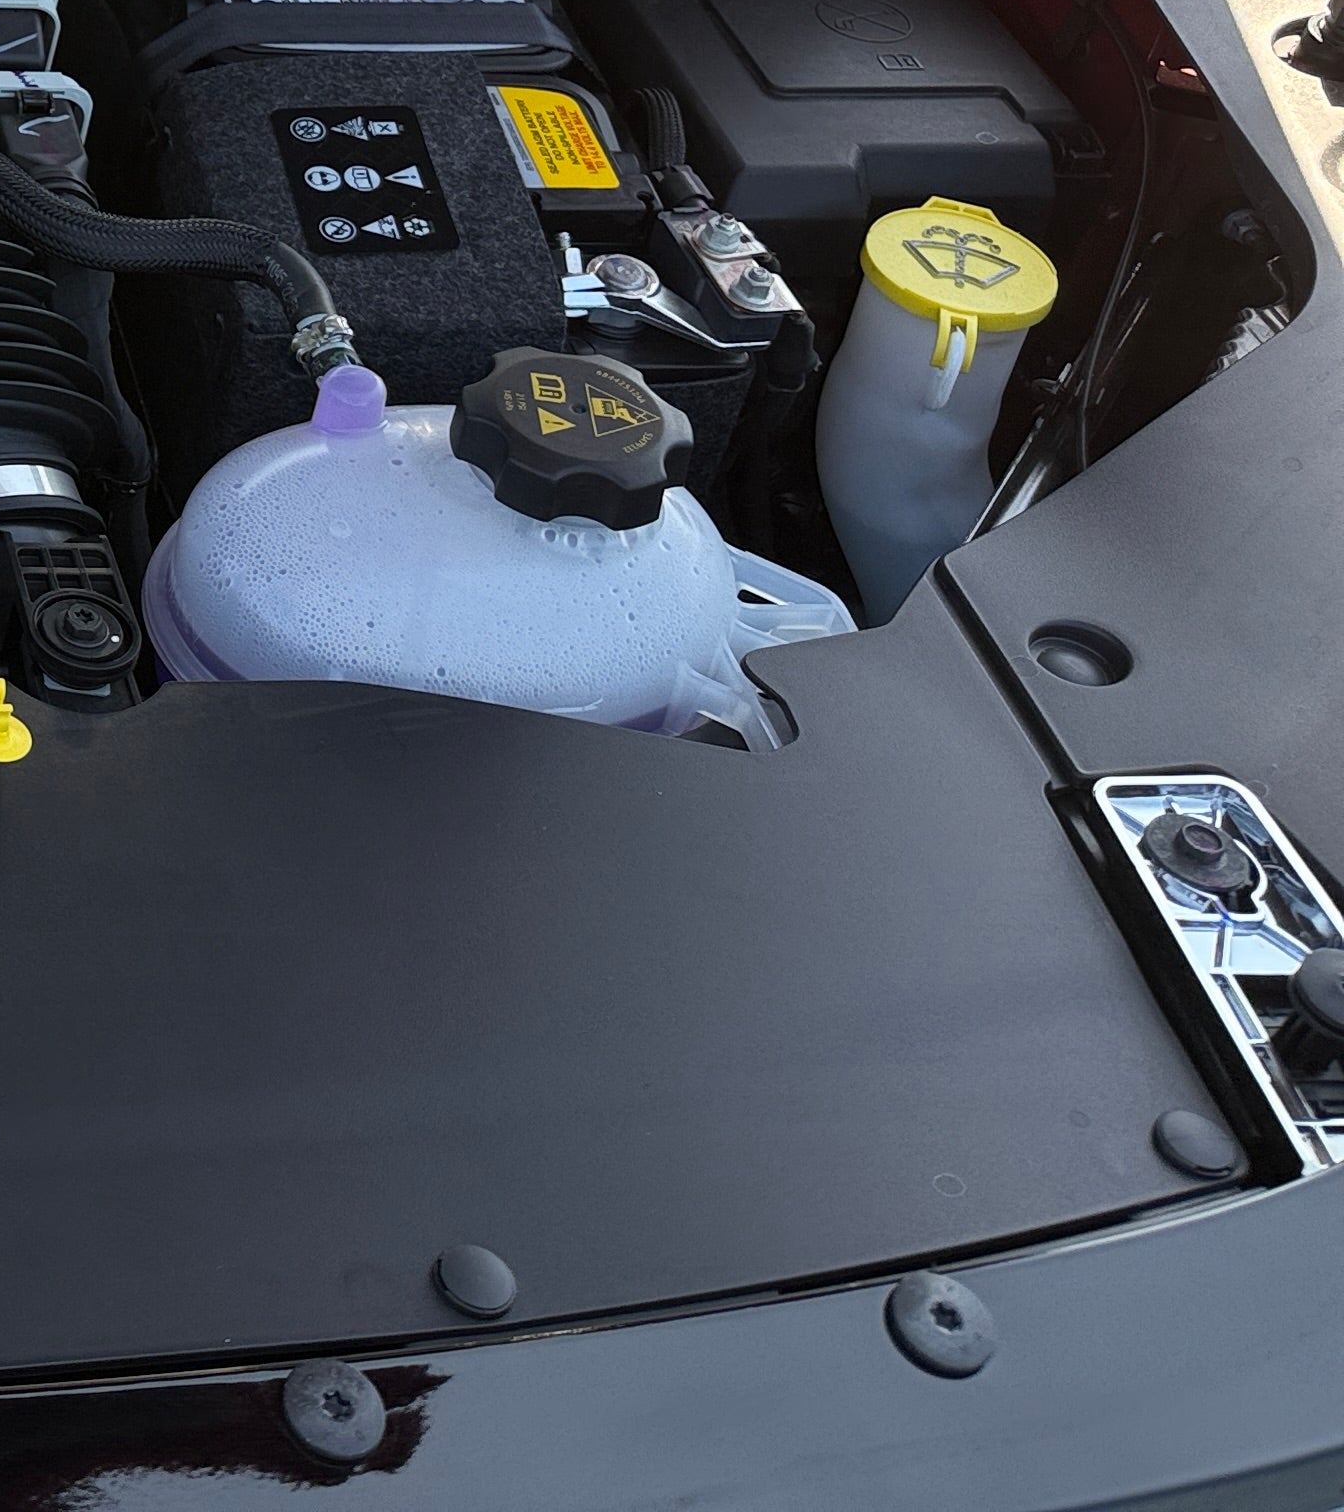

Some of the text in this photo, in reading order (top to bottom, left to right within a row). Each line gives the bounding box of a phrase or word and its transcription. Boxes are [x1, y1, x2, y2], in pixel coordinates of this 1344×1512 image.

[514, 99, 536, 128] BATTERY
[544, 134, 558, 148] NOT
[537, 146, 559, 173] SEALED
[551, 150, 564, 160] DO
